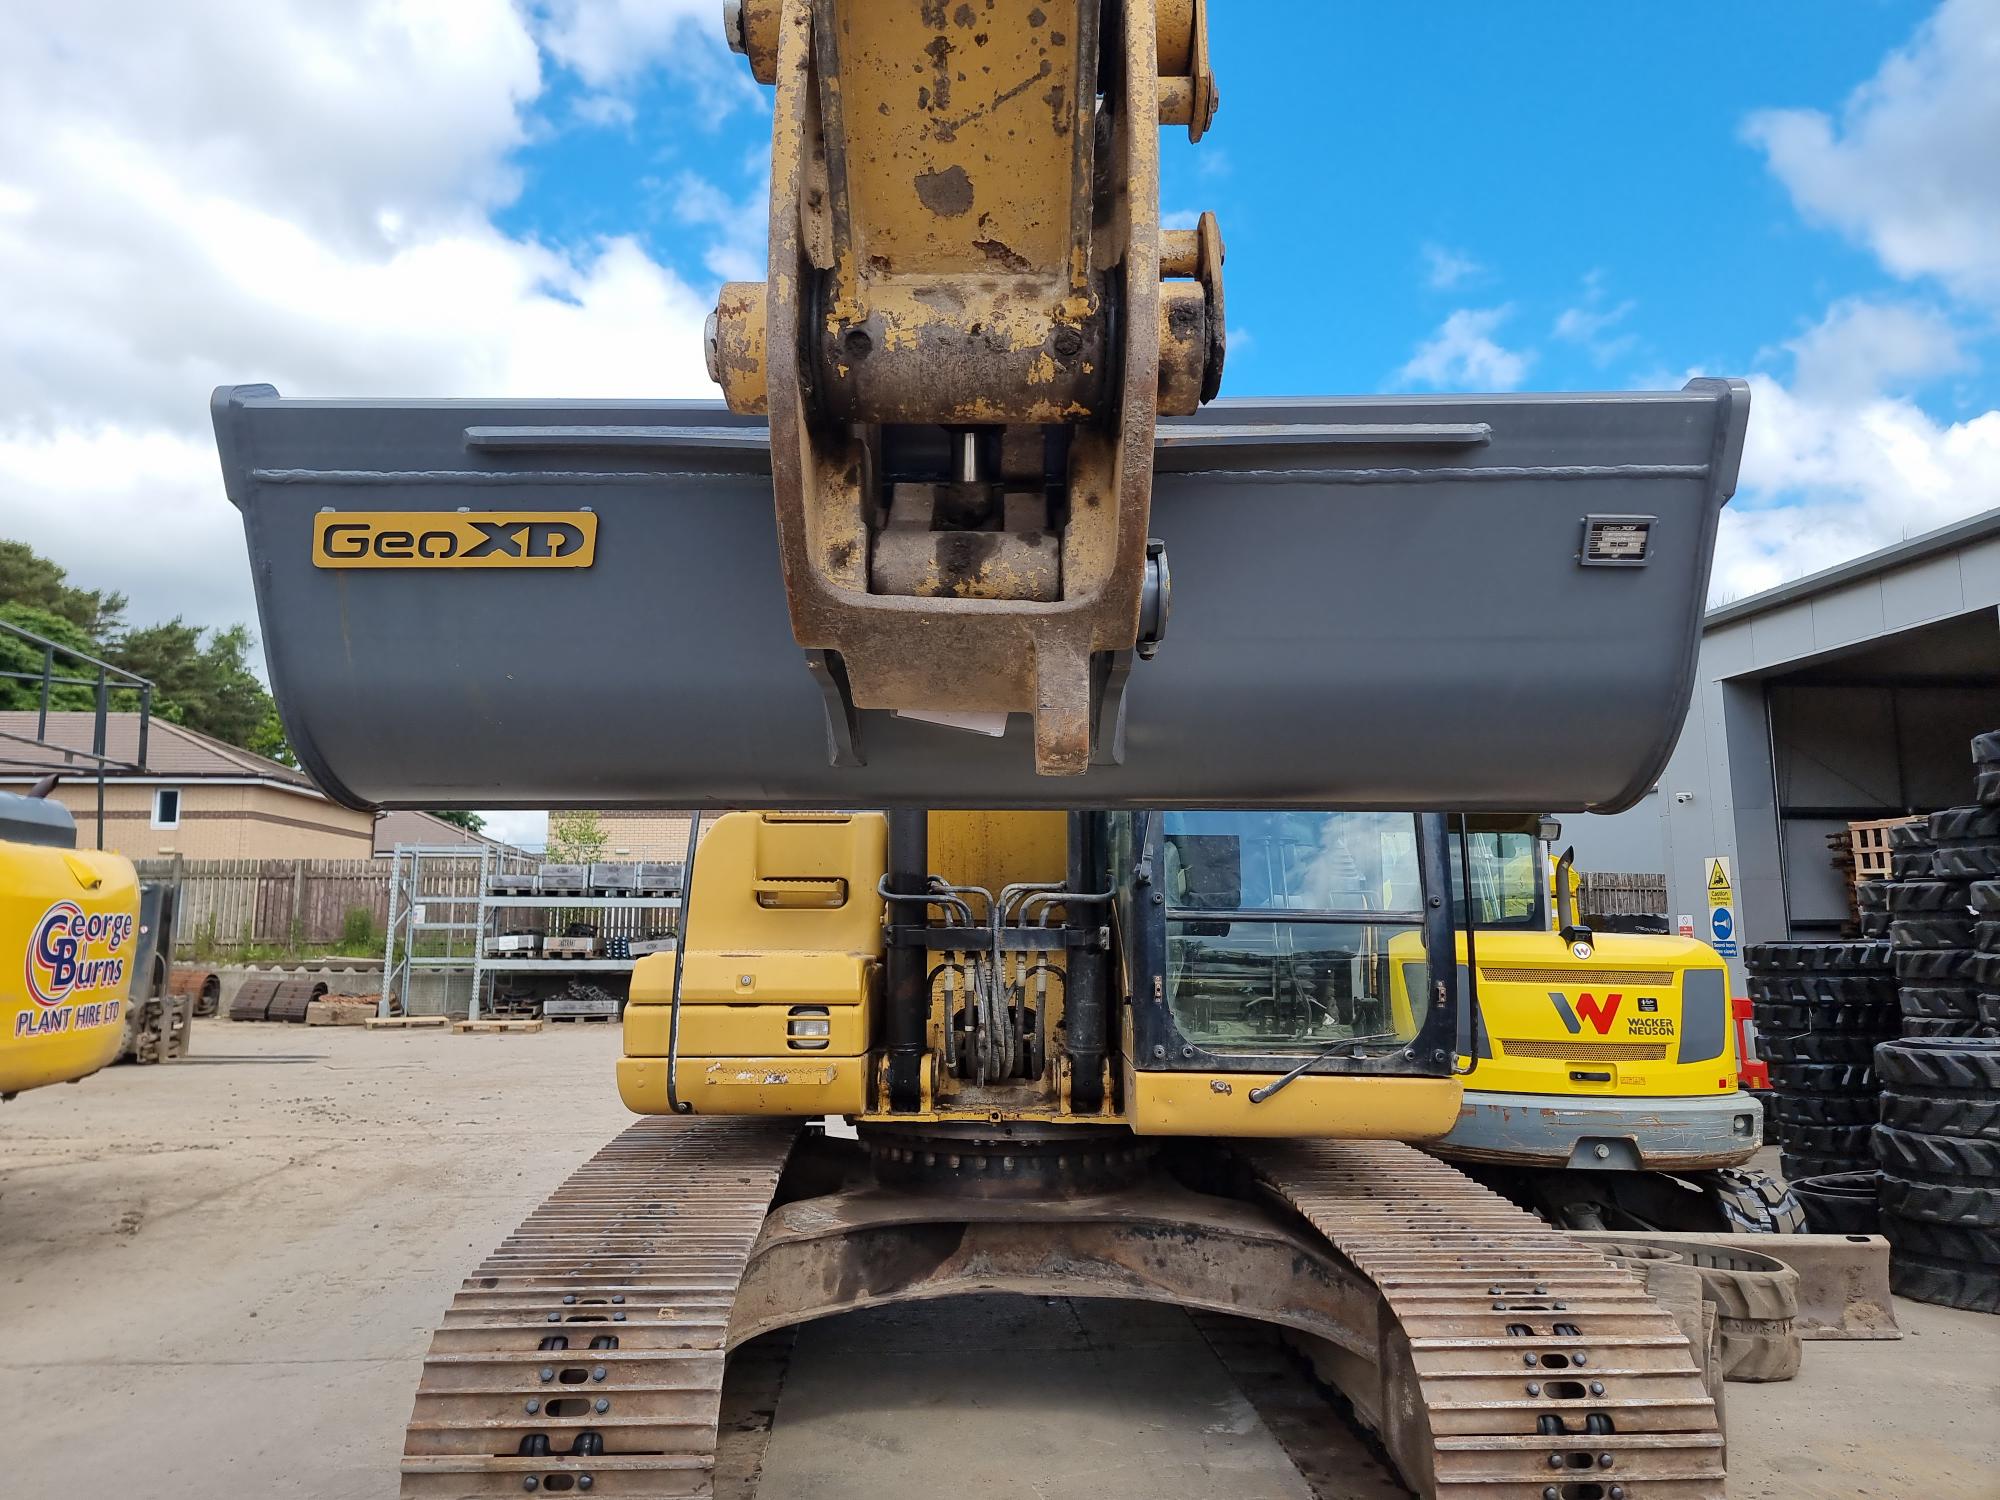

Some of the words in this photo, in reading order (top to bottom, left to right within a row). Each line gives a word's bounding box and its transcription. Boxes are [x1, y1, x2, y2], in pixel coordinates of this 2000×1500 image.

[38, 913, 133, 966] George
[52, 937, 124, 989] Burns
[15, 1008, 72, 1037] PLANT
[75, 1004, 102, 1029] HIRE
[104, 1001, 120, 1024] LTD
[1627, 1018, 1673, 1027] WACKER
[1628, 1027, 1675, 1036] NEUSON
